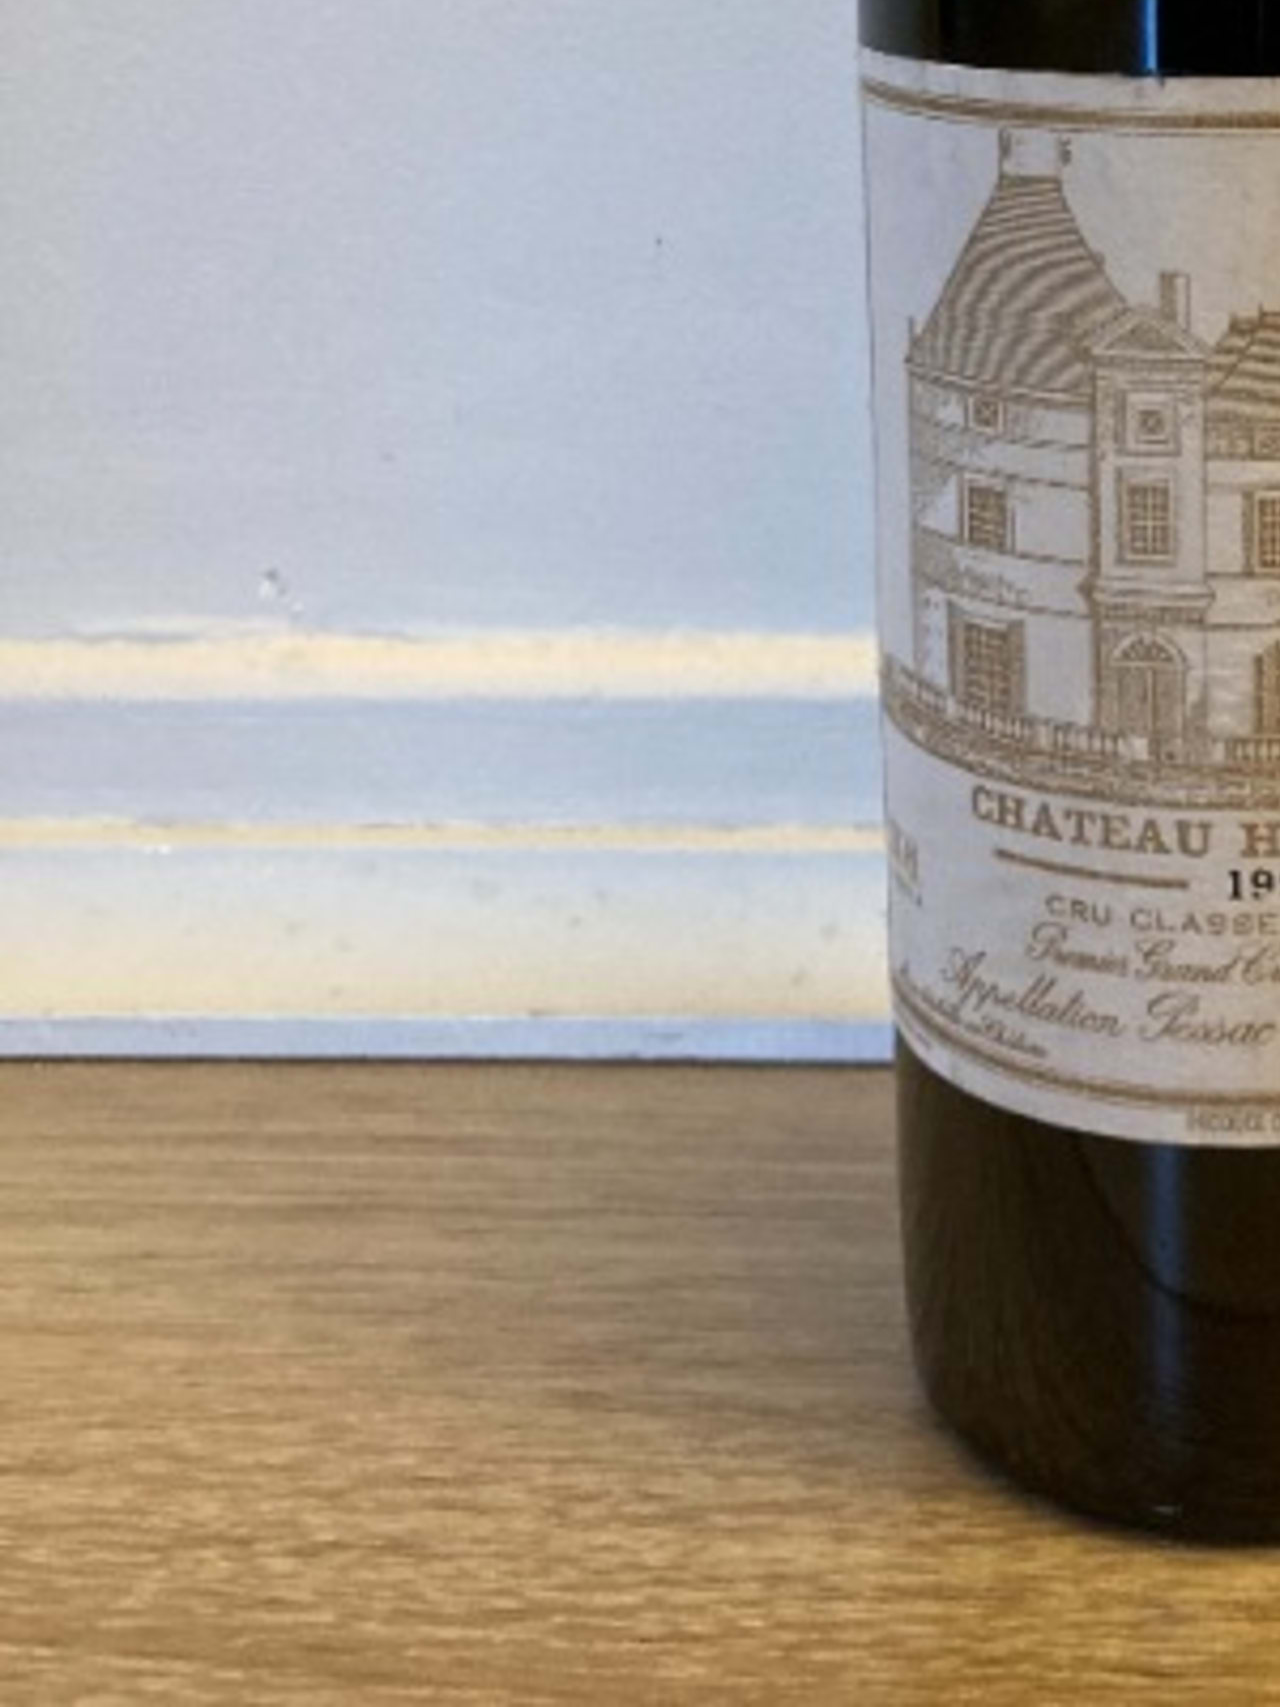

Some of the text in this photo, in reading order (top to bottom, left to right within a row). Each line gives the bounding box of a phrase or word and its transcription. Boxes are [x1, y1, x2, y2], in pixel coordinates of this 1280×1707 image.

[971, 785, 1213, 857] CHATEAU
[1045, 894, 1111, 927] CRU
[939, 946, 1125, 1038] Appellation
